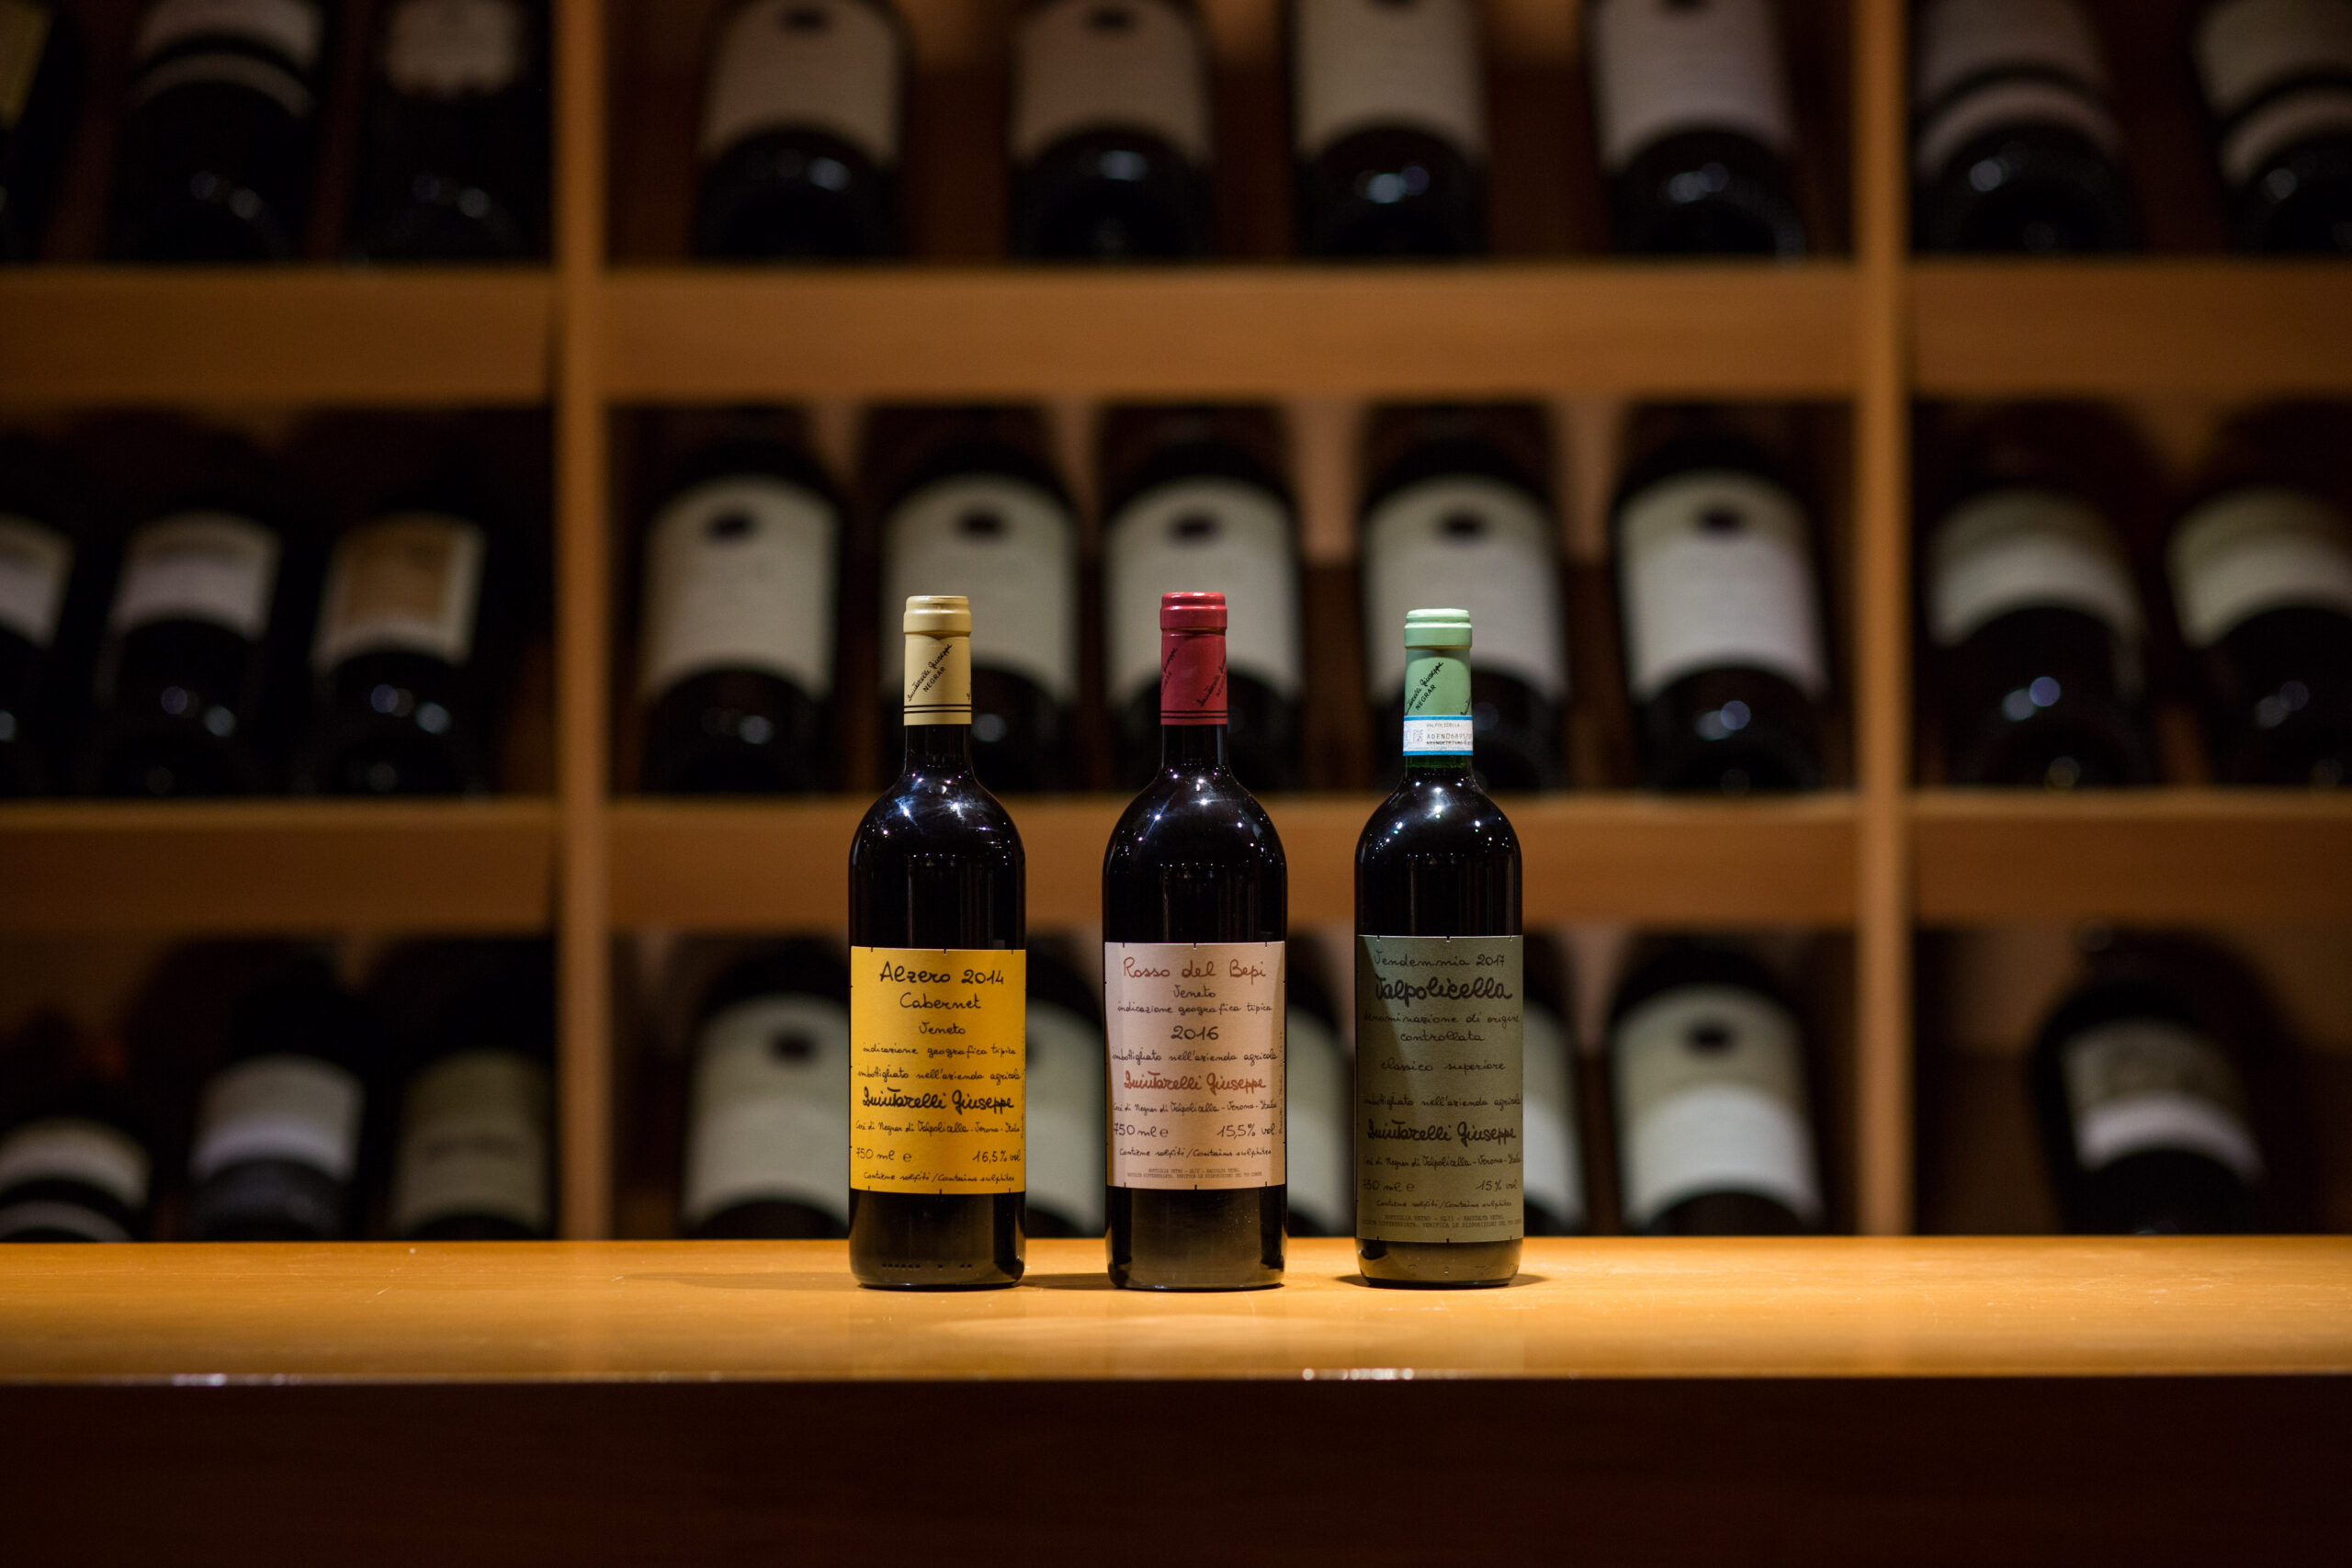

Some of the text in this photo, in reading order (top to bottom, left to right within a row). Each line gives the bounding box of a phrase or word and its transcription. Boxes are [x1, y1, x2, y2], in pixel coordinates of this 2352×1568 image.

[922, 666, 945, 693] NEGRAR
[1415, 683, 1437, 711] NEGRAR
[1374, 951, 1504, 967] Vendemmia 2017
[880, 961, 1004, 985] Alzero 2014
[1123, 956, 1266, 985] Rosso del Bepi
[1173, 985, 1216, 998] Veneto
[1376, 975, 1513, 1007] Valpolicella
[900, 992, 981, 1009] Cabernet
[1117, 1000, 1272, 1016] indicazione geografica tipica
[1466, 1012, 1480, 1022] di
[919, 1021, 966, 1034] Veneto
[1170, 1025, 1219, 1041] 2016
[1400, 1030, 1485, 1042] controllata
[864, 1043, 1016, 1058] indicazione geografica tipica
[1381, 1057, 1506, 1075] classico superiore
[1206, 1072, 1266, 1095] Giuseppe
[952, 1089, 1014, 1115] Giuseppe
[1159, 1103, 1168, 1112] di
[1170, 1102, 1219, 1116] Valpolicella
[906, 1122, 914, 1132] di
[918, 1121, 968, 1137] Valpolicella
[1114, 1122, 1136, 1136] 750
[1137, 1126, 1157, 1137] ml
[1216, 1123, 1275, 1139] 15,5% vol
[1457, 1122, 1517, 1147] Giuseppe
[856, 1148, 873, 1159] 750
[876, 1150, 895, 1160] ml
[1010, 1149, 1021, 1161] vol
